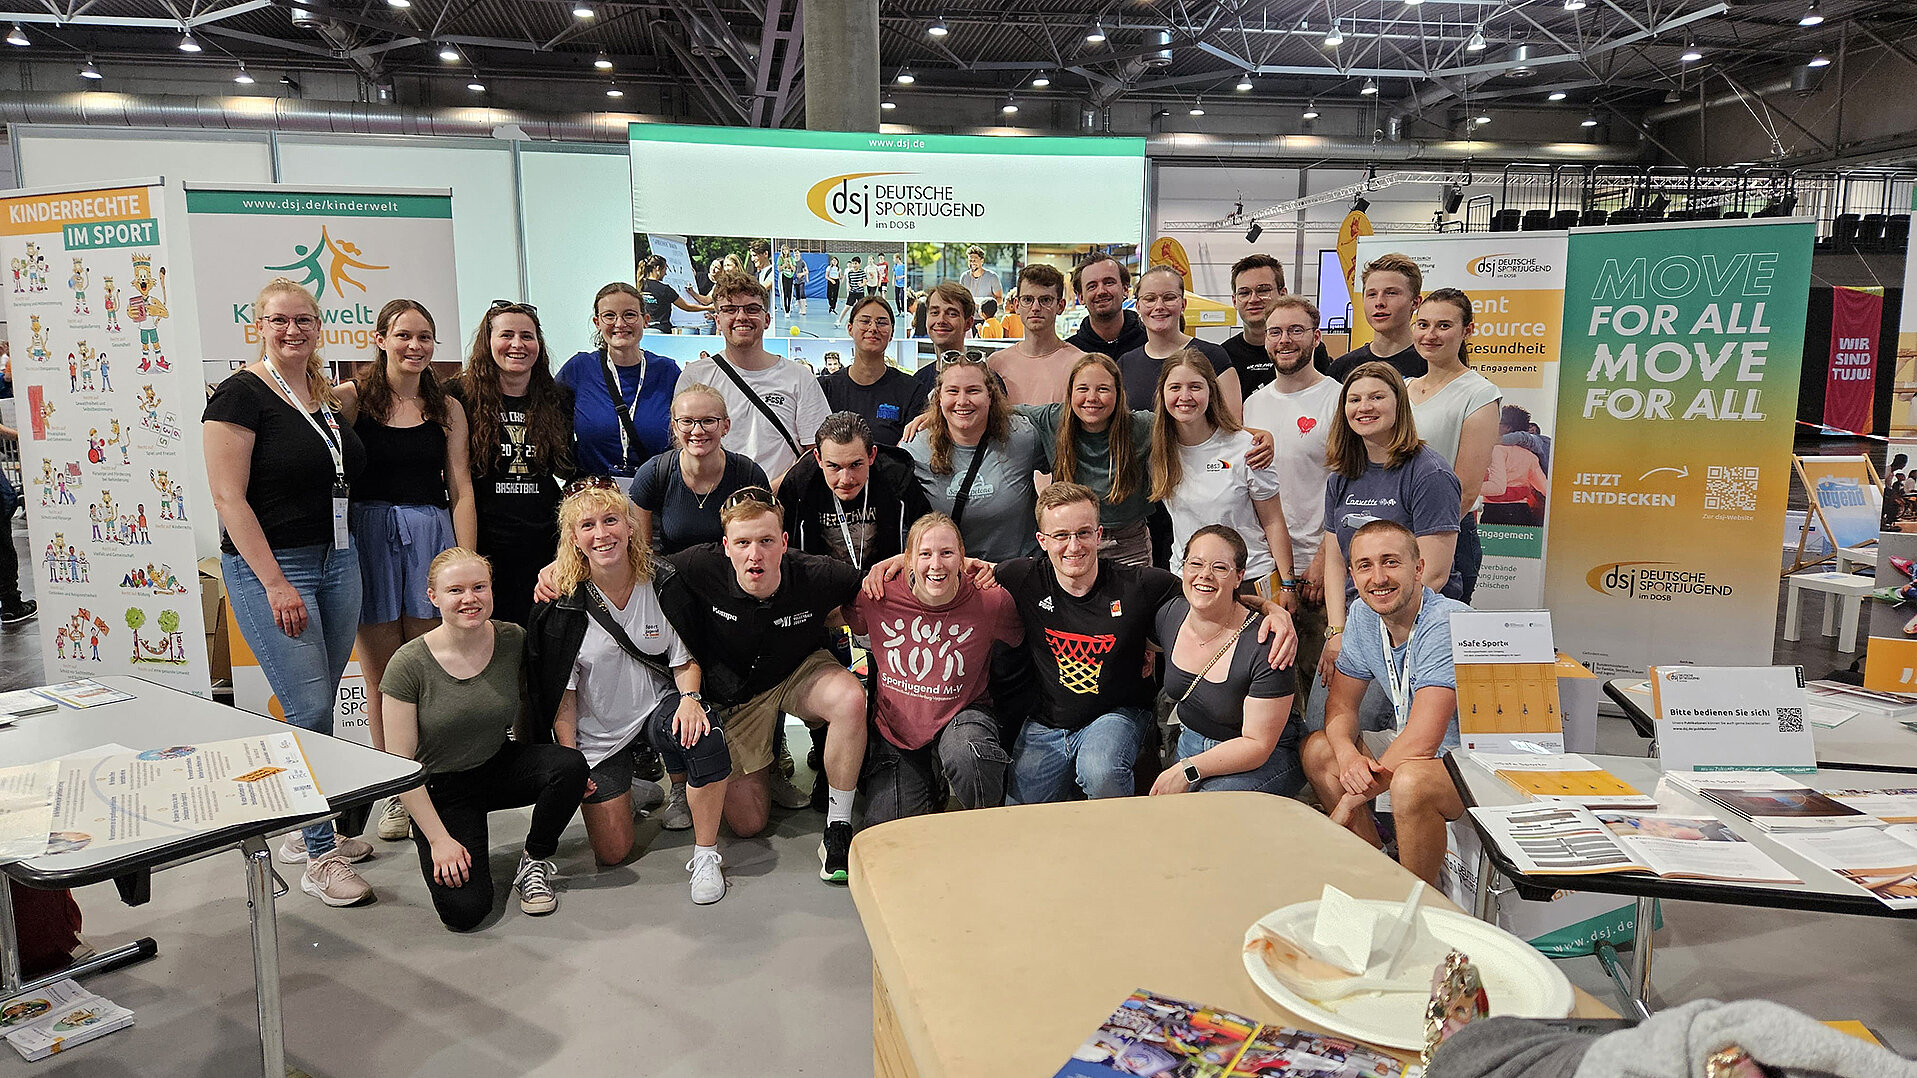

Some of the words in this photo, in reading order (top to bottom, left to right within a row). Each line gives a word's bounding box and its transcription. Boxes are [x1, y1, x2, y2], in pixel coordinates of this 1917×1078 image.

[869, 138, 925, 150] www.dsj.de
[875, 185, 953, 201] DEUTSCHE
[9, 194, 141, 225] KINDERRECHTE
[242, 199, 399, 213] www.dsj.de/kinderwelt
[832, 178, 869, 228] dsj
[875, 201, 985, 217] SPORTJUGEND
[875, 221, 888, 229] im
[890, 221, 916, 229] DOSB
[67, 226, 90, 247] IM
[93, 222, 153, 246] SPORT
[1477, 257, 1496, 278] dsj
[1497, 265, 1552, 273] SPORTJUGEND
[1591, 252, 1779, 300] MOVE
[1472, 296, 1509, 313] ent
[233, 303, 374, 324] Kiwelt
[1588, 304, 1679, 337] FOR
[1689, 302, 1771, 335] ALL
[1472, 322, 1546, 337] source
[1466, 342, 1546, 354] Gesundheit
[1839, 337, 1870, 350] WIR
[1586, 342, 1769, 383] MOVE
[1835, 352, 1871, 366] SIND
[1480, 364, 1537, 373] Engagement
[1832, 367, 1871, 381] TUJU!
[1582, 388, 1677, 421] FOR
[1682, 388, 1767, 421] ALL
[1573, 473, 1622, 487] JETZT
[495, 482, 540, 494] BASKETBALL
[1572, 491, 1676, 507] ENTDECKEN
[1816, 487, 1866, 509] jugend
[1477, 529, 1534, 541] Engagement
[1480, 563, 1518, 572] tverbände
[1479, 573, 1491, 581] ung
[1492, 573, 1517, 581] junger
[1605, 565, 1635, 598] dsj
[1640, 569, 1705, 583] DEUTSCHE
[1475, 581, 1510, 590] ychischen
[1639, 581, 1733, 597] SPORTJUGEND
[712, 605, 738, 621] Kempa
[1458, 639, 1481, 648] »Safe
[1482, 639, 1509, 649] Sport«
[881, 672, 941, 694] Sportjugend
[943, 683, 964, 695] M-V
[1670, 708, 1692, 716] Bitte
[1693, 708, 1734, 717] bedienen
[1735, 708, 1749, 717] Sie
[1750, 708, 1771, 717] sich!
[342, 719, 354, 728] im
[1552, 920, 1634, 953] www.dsj.de
